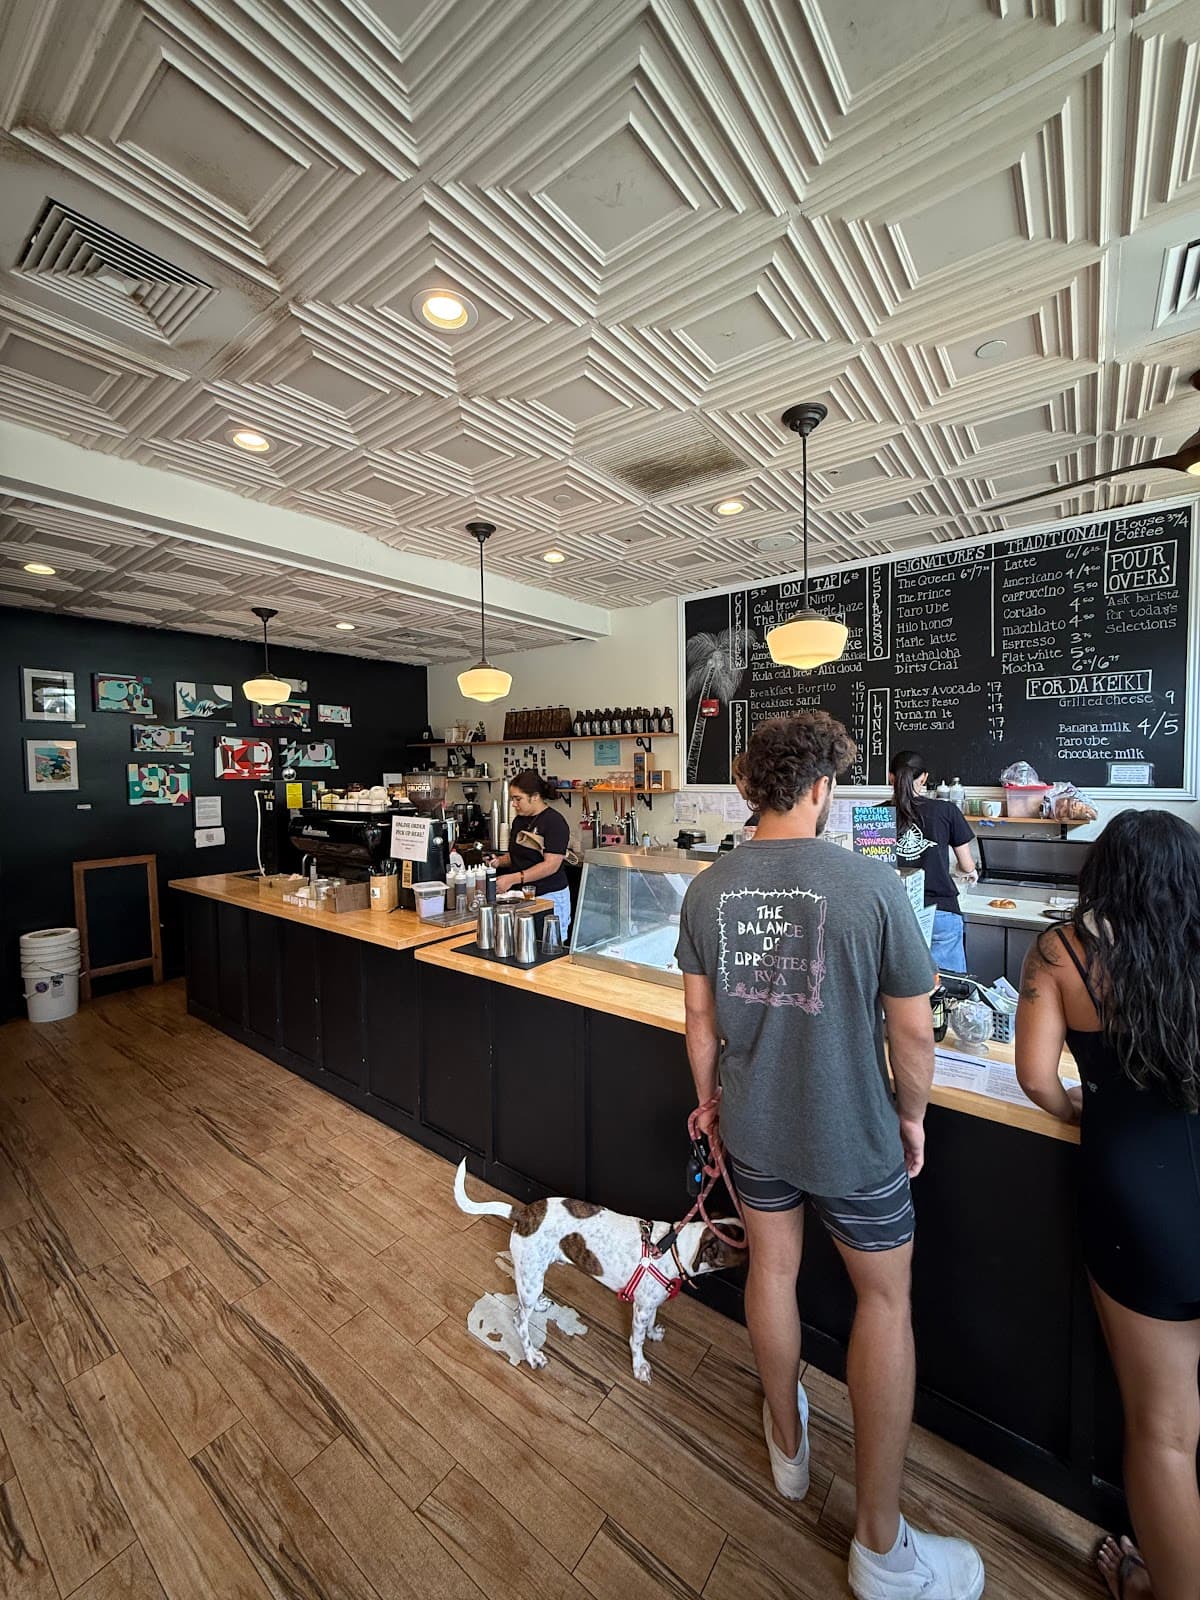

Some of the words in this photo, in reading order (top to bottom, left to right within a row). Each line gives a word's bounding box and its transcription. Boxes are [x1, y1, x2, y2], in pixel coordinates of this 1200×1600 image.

[1115, 516, 1166, 531] House
[1004, 523, 1108, 555] TRADITIONAL
[1114, 526, 1165, 542] Coffee
[897, 546, 986, 574] SIGNATURES
[1004, 556, 1038, 572] Latte
[1111, 545, 1166, 572] POUR
[783, 582, 801, 596] ON
[813, 575, 838, 590] TAP
[898, 578, 916, 589] The
[918, 571, 956, 587] Queen
[1002, 570, 1063, 589] Americano
[1109, 565, 1171, 591] OVERS
[809, 594, 835, 605] Nitro
[897, 593, 916, 604] The
[917, 588, 952, 602] Prince
[1136, 589, 1180, 603] barista
[754, 600, 774, 615] Cold
[775, 599, 799, 610] brew
[816, 605, 837, 616] urple
[839, 601, 863, 613] haze
[897, 606, 923, 618] Taro
[925, 602, 950, 614] Ube
[1003, 604, 1047, 620] Cortado
[754, 615, 775, 626] The
[777, 610, 794, 622] Kin
[897, 621, 919, 634] Hilo
[920, 617, 953, 631] honey
[848, 627, 863, 638] hip
[1002, 619, 1066, 636] macchiato
[895, 636, 925, 649] Maple
[930, 632, 958, 645] latte
[1002, 636, 1056, 650] Espresso
[752, 652, 772, 661] Almo
[895, 647, 962, 663] Matchaloha
[1002, 651, 1026, 663] Flat
[1027, 648, 1064, 661] white
[752, 671, 773, 681] Kula
[774, 669, 791, 679] cold
[792, 669, 812, 678] brew
[837, 662, 862, 673] cloud
[894, 662, 927, 675] Dirty
[929, 659, 958, 671] Chai
[1002, 661, 1045, 675] Mocha
[750, 685, 792, 698] Breakfast
[798, 683, 836, 695] Burrito
[894, 687, 930, 699] Turkey
[931, 682, 981, 696] Avocado
[1030, 681, 1066, 697] FOR
[1069, 678, 1089, 694] DA
[1091, 673, 1145, 693] KEIKI
[751, 698, 794, 709] Breakfast
[796, 694, 820, 705] sand
[894, 698, 929, 710] Turkey
[931, 698, 960, 707] Pesto
[1058, 696, 1103, 708] Grilled
[1165, 690, 1175, 705] 9
[751, 709, 791, 720] Croissant
[894, 710, 922, 721] Tuna
[872, 694, 883, 756] LUNCH
[894, 721, 928, 731] Veggie
[930, 720, 955, 730] sand
[1058, 723, 1099, 734] Banana
[1101, 721, 1132, 733] milk
[1137, 711, 1179, 740] 4/5
[1056, 736, 1083, 747] Taro
[1084, 736, 1110, 746] ube
[1057, 748, 1114, 760] Chocolate
[1114, 748, 1145, 760] milk
[862, 846, 892, 856] MANGO
[757, 905, 784, 919] THE
[737, 921, 804, 938] BALANCE
